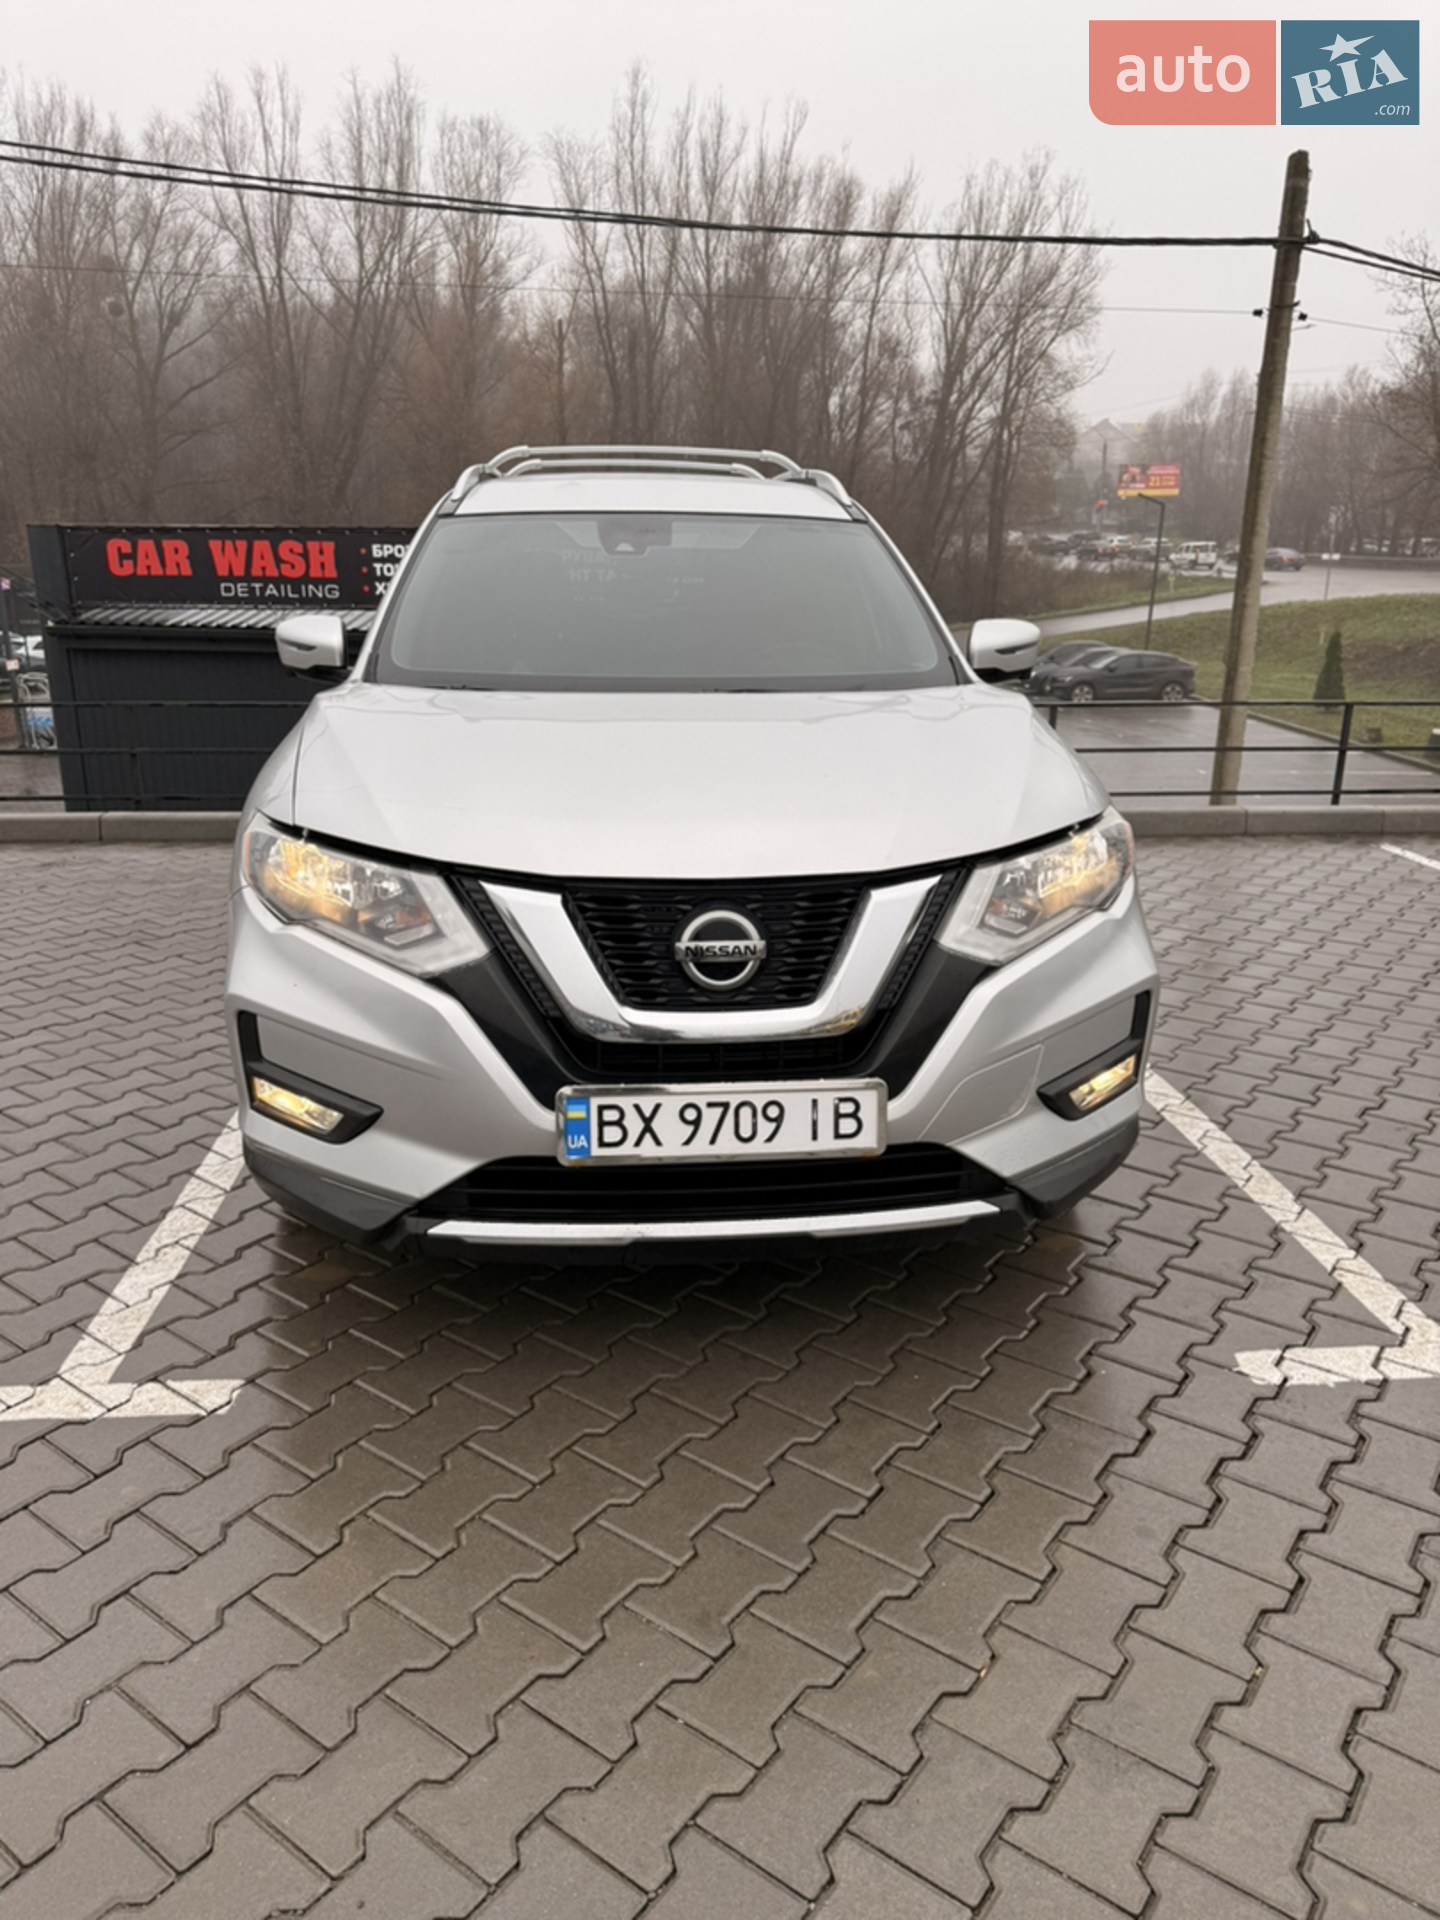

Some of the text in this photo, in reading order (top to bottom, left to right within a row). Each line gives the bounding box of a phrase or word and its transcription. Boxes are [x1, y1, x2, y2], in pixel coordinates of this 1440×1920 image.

[105, 538, 338, 580] CAR WASH
[219, 582, 340, 598] DETAILING
[374, 581, 390, 596] Х
[684, 944, 758, 958] NISSAN
[596, 1103, 663, 1148] BX
[678, 1100, 785, 1146] 9709
[567, 1135, 588, 1148] UA
